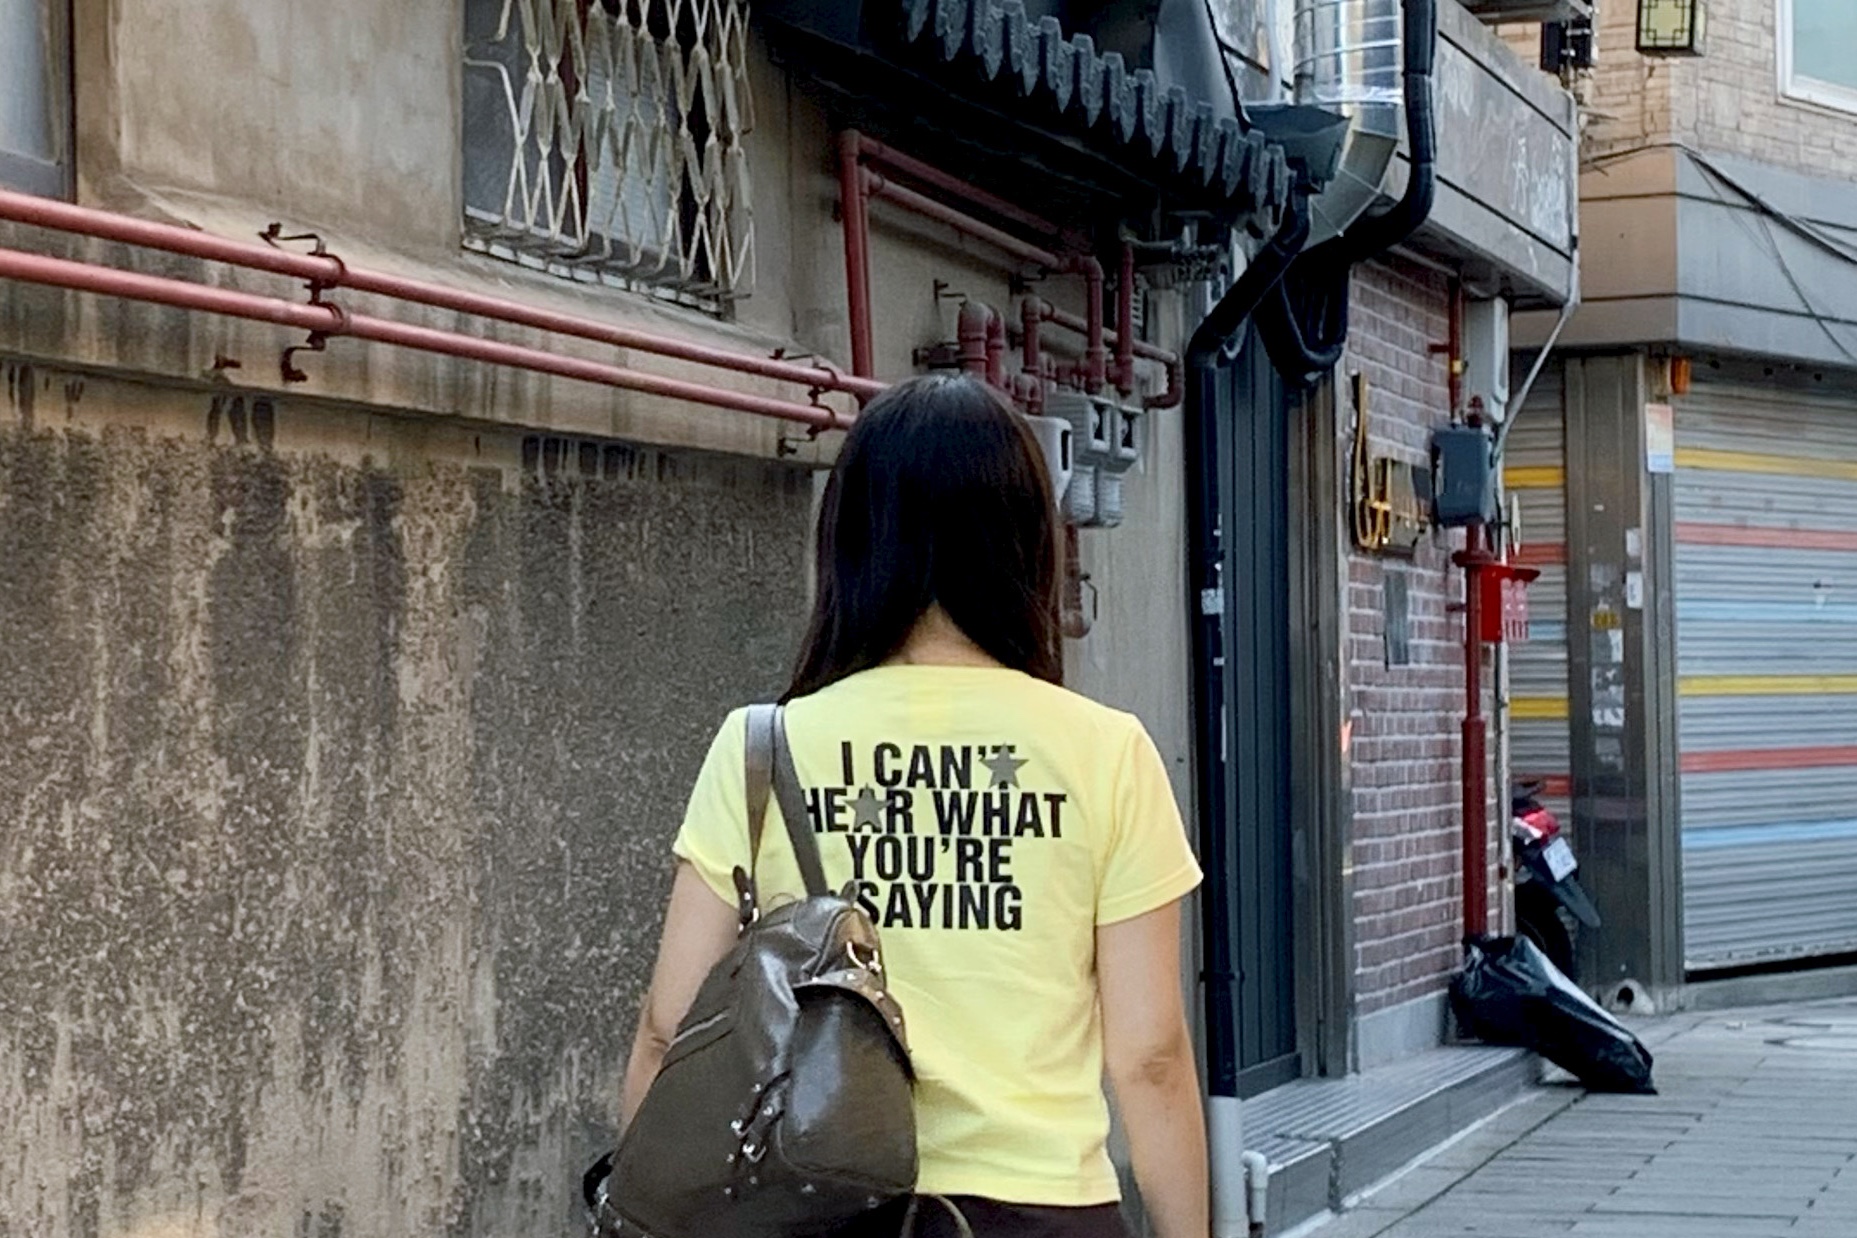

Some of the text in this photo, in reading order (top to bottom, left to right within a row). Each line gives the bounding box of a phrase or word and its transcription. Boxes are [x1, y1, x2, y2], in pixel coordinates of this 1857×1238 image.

[842, 741, 854, 786] I
[932, 791, 1067, 838] WHAT
[845, 834, 1013, 883] YOU'RE
[857, 881, 1022, 931] SAYING
